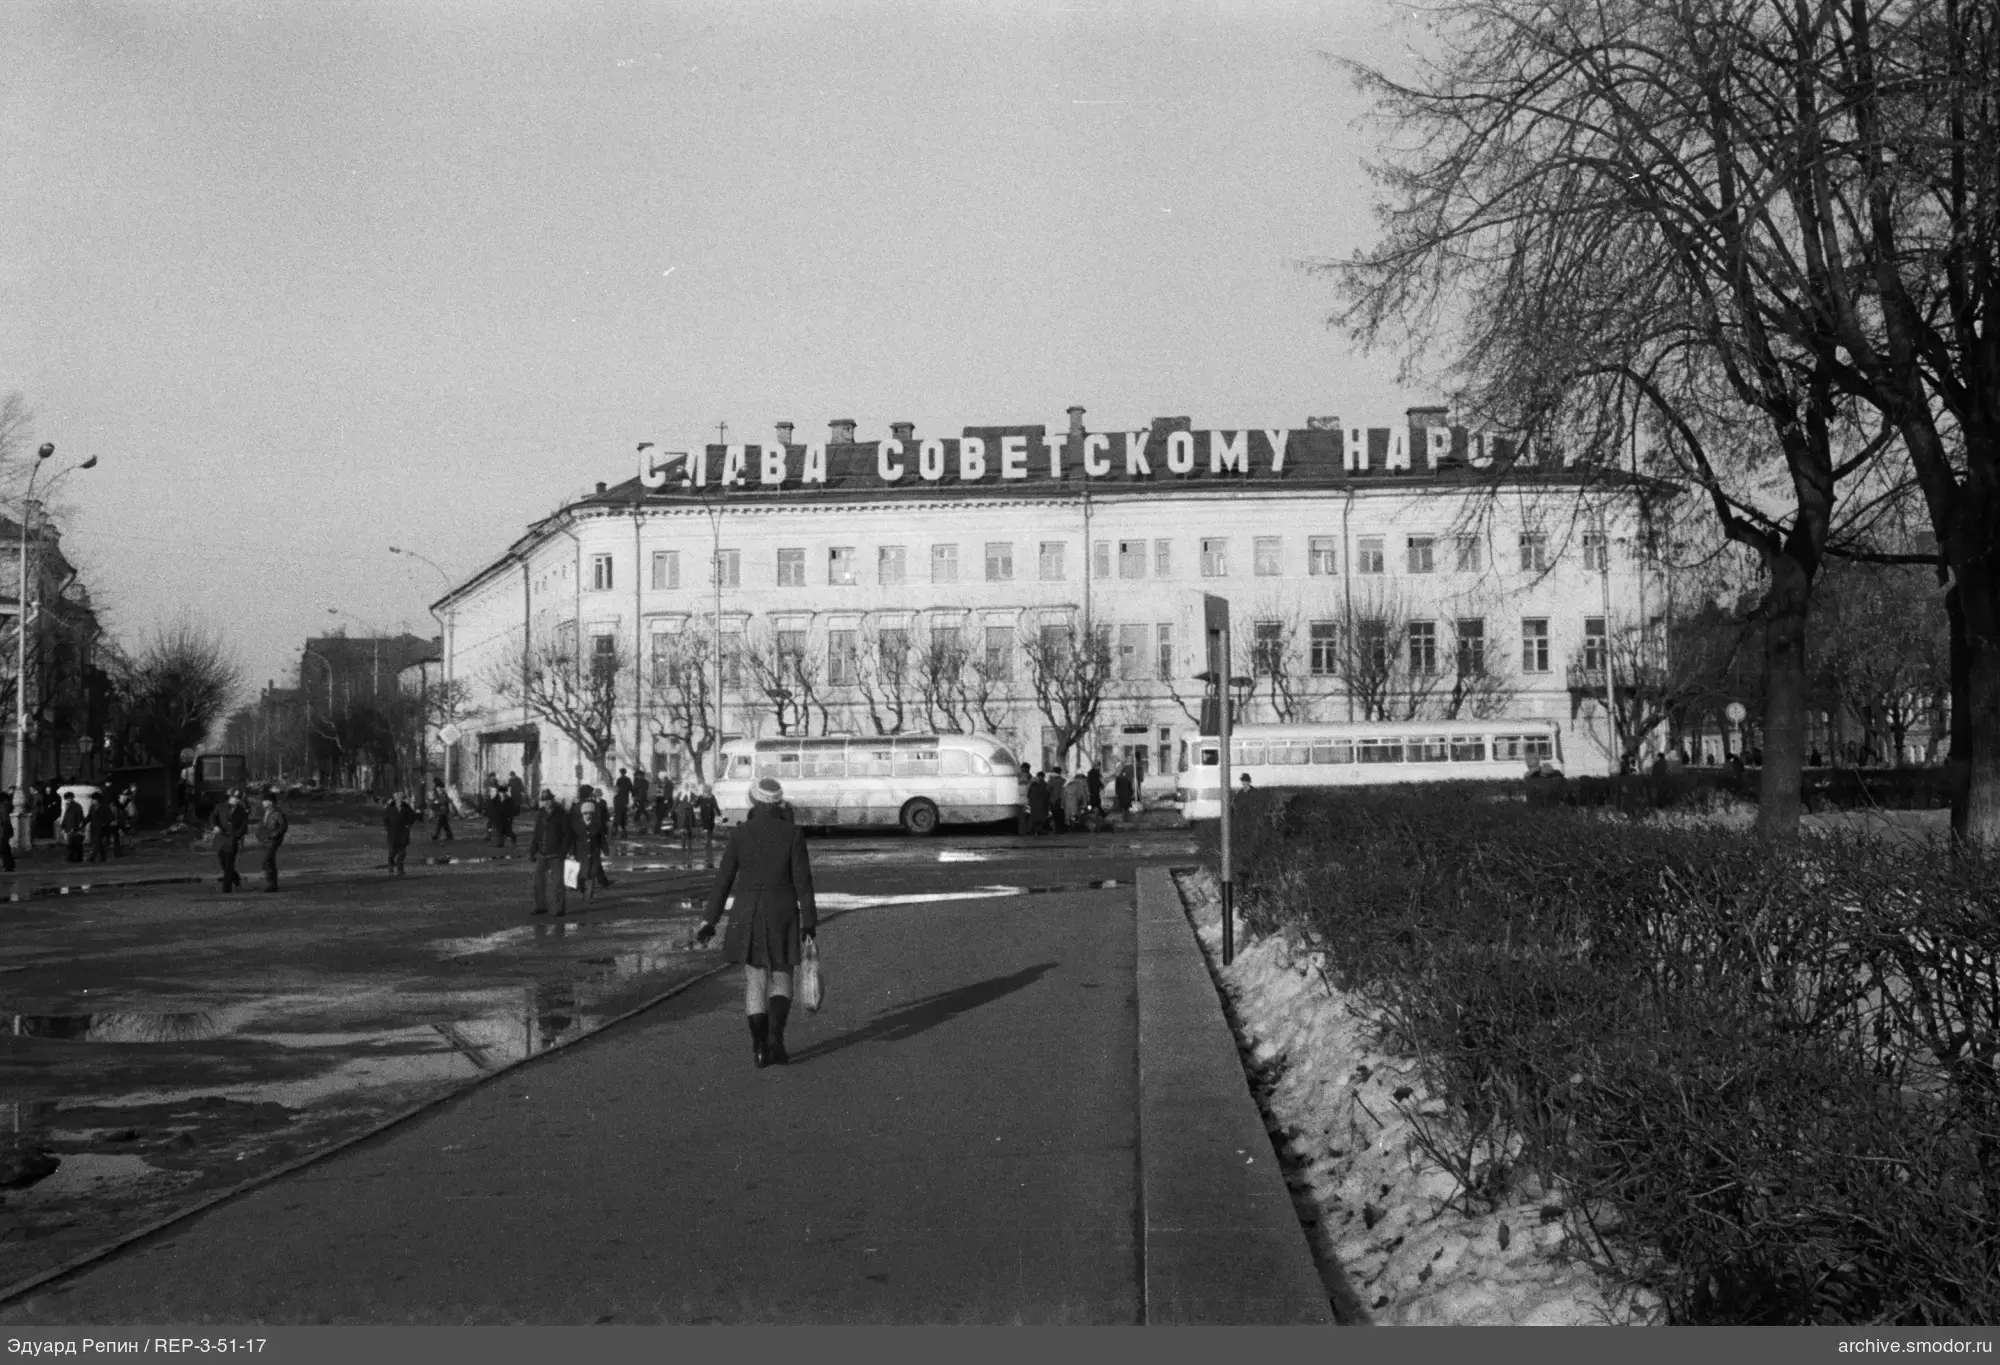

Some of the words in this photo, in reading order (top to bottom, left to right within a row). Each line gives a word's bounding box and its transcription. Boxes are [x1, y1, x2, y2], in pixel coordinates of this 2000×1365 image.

[639, 442, 827, 488] СЛАВА
[878, 428, 1289, 481] СОВЕТСКОМУ
[1342, 428, 1584, 471] НАРО
